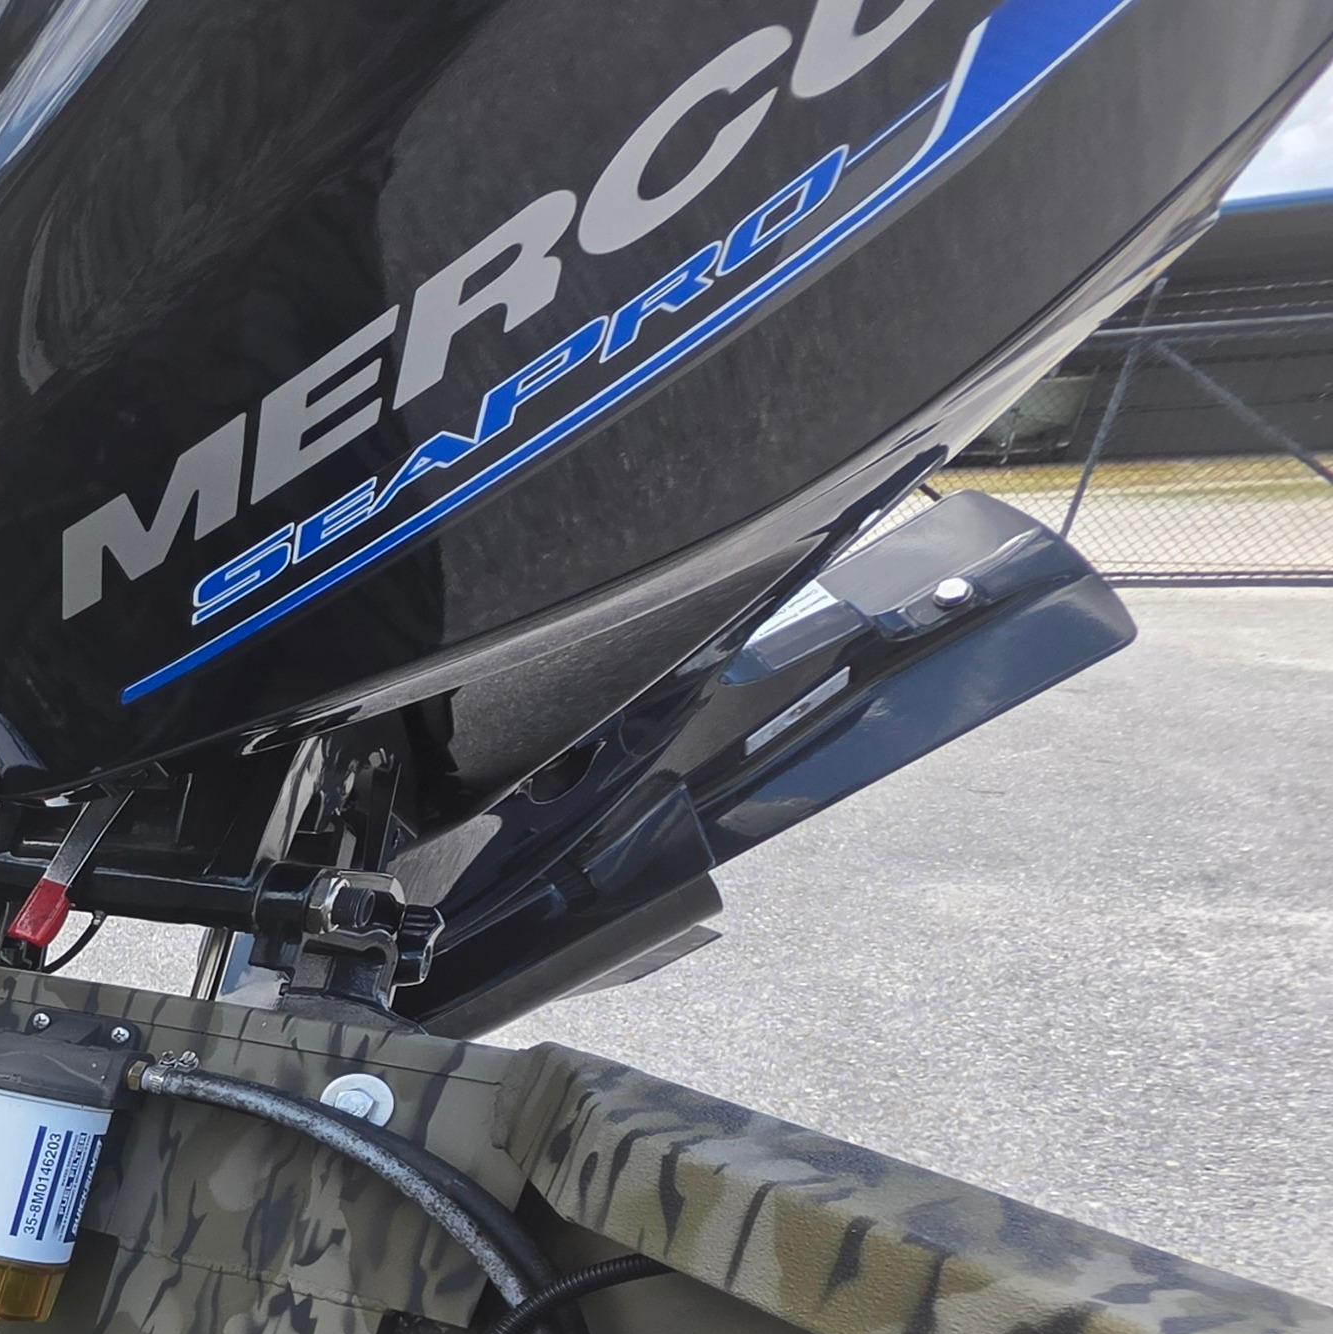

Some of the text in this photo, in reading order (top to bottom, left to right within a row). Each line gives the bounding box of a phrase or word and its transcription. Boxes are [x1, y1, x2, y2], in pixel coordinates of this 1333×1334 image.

[23, 1132, 62, 1235] 35-8M0146203
[58, 1133, 87, 1216] FUEL FILTER
